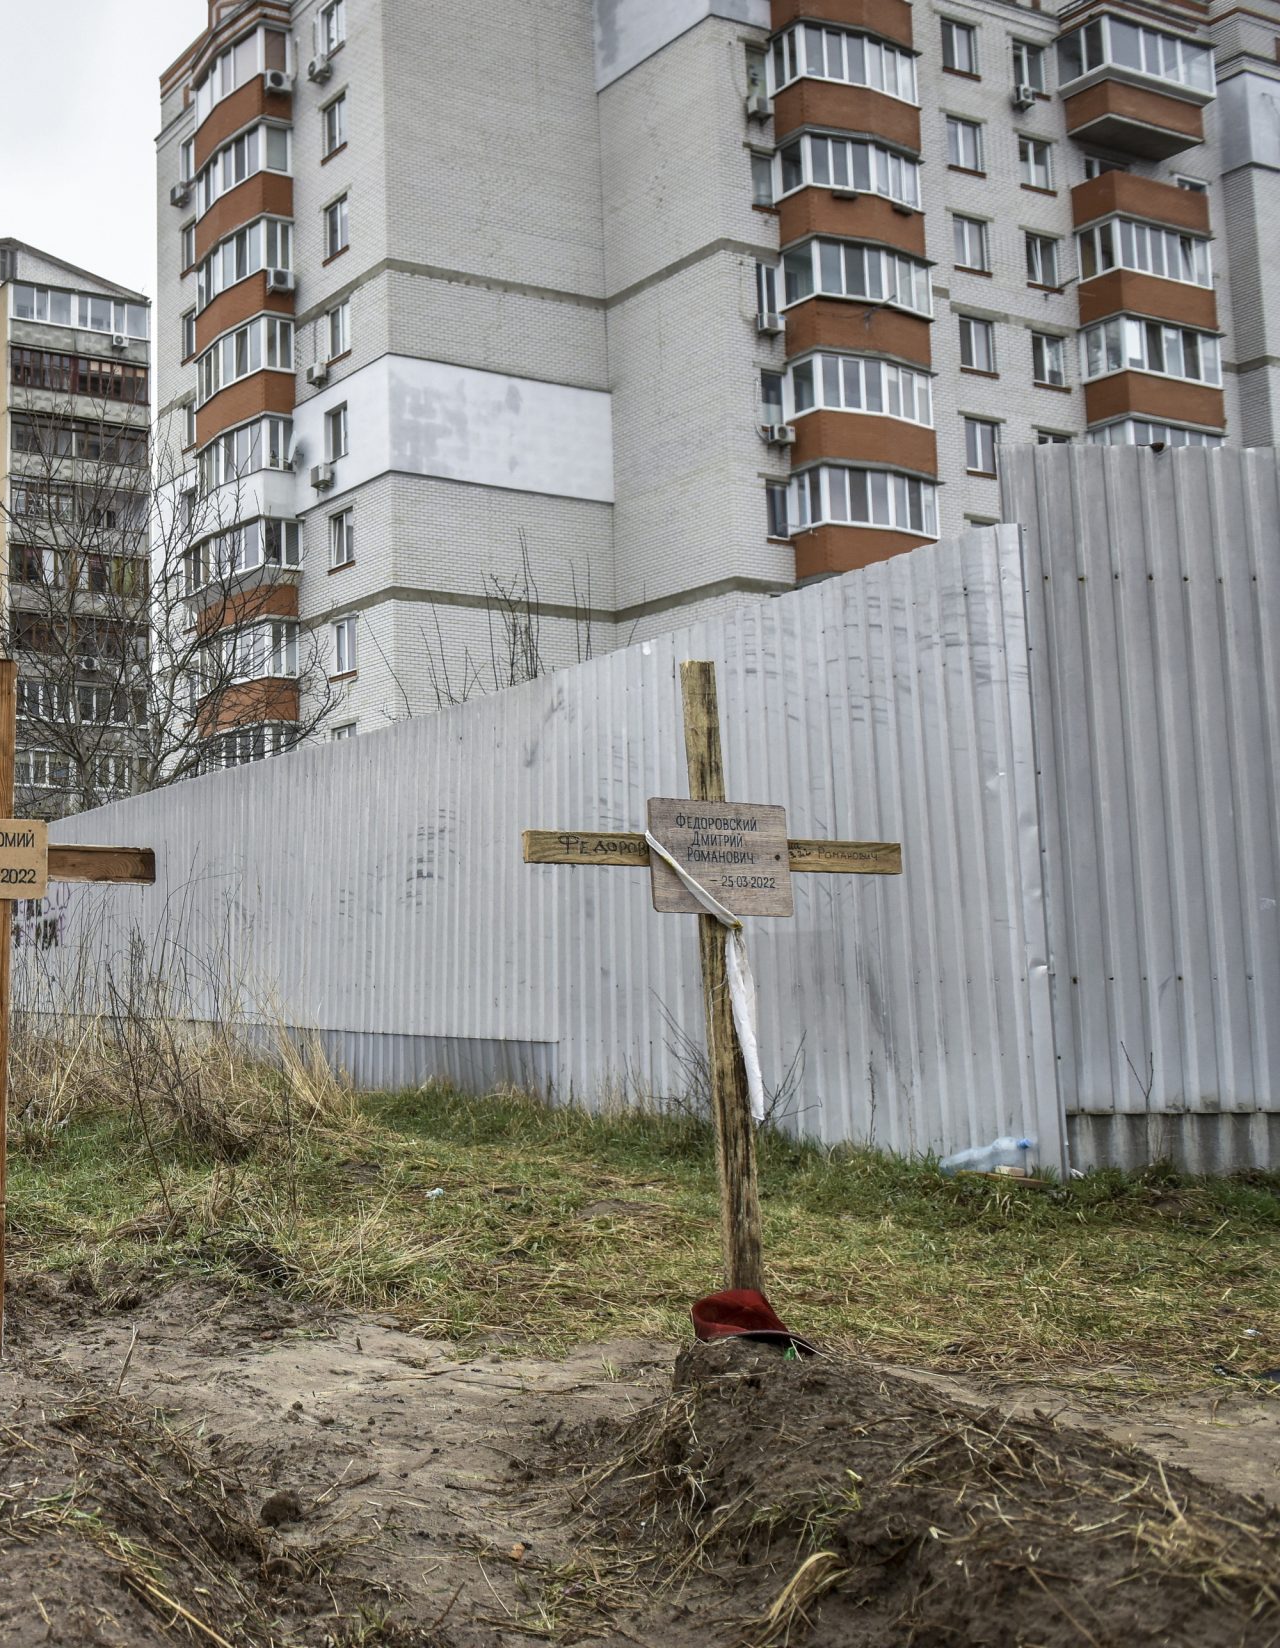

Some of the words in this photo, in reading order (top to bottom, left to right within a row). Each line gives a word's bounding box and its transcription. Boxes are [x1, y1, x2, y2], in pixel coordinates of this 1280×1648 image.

[675, 813, 757, 831] ФЕДОРОВСКИЙ
[691, 831, 743, 848] ДМИТРИЙ
[687, 847, 754, 864] РОМАНОВИЧ
